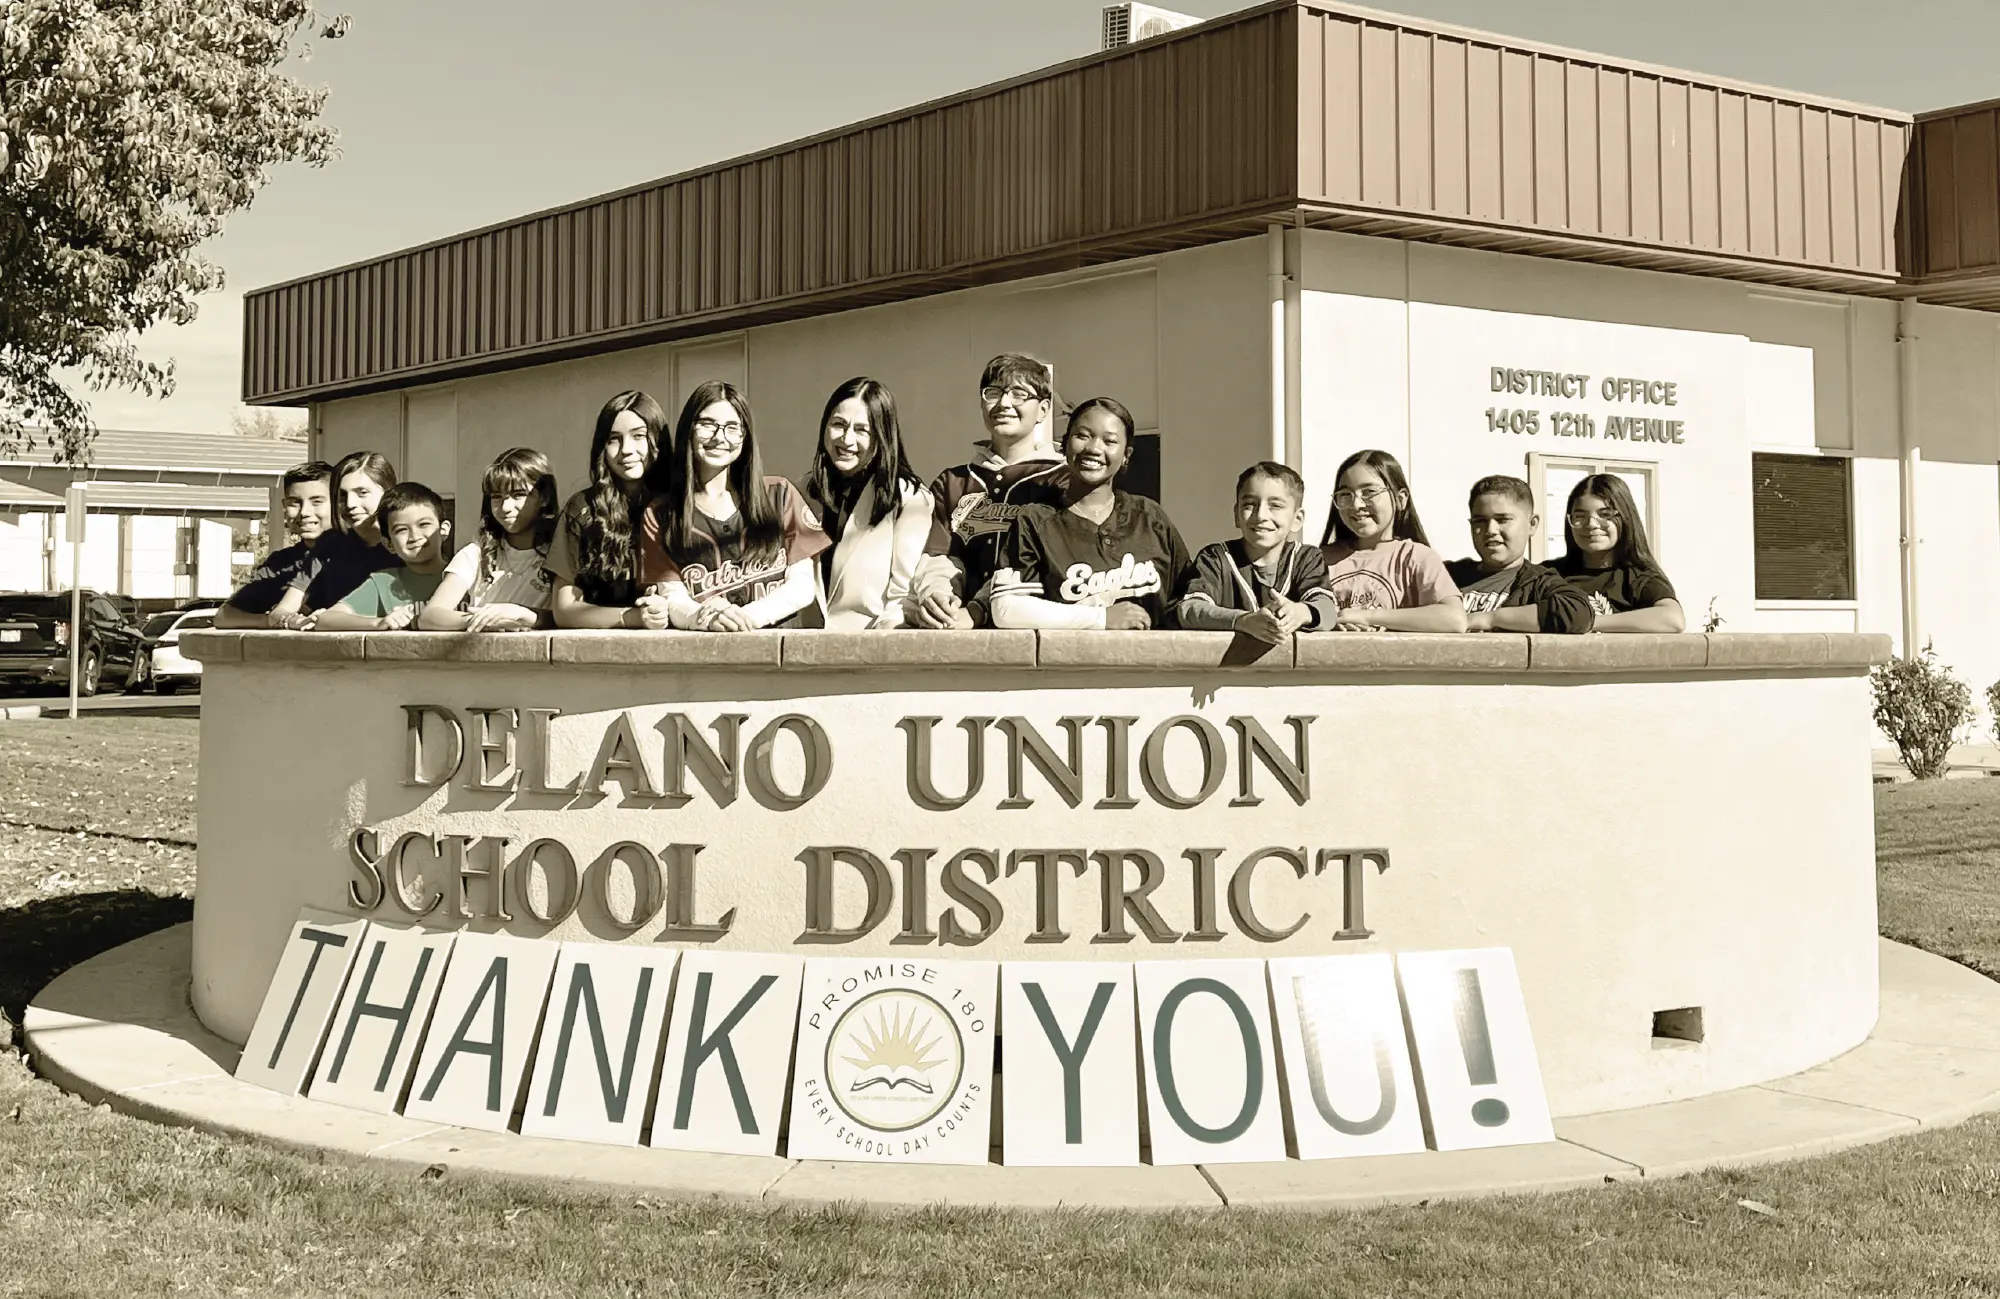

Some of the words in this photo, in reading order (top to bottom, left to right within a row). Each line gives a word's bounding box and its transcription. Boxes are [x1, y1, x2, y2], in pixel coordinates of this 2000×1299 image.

[1490, 366, 1590, 399] DISTRICT
[1601, 376, 1678, 406] OFFICE
[1485, 406, 1540, 435] 1405
[1550, 411, 1595, 438] 12th
[1603, 415, 1685, 444] AVENUE
[1060, 553, 1161, 601] Eagles
[400, 704, 834, 812] DELANO
[896, 715, 1319, 812] UNION
[347, 827, 738, 943] SCHOOL
[793, 845, 1390, 946] DISTRICT
[267, 927, 780, 1135] THANK
[808, 964, 937, 1030] PROMISE
[951, 988, 985, 1034] 180
[804, 1079, 835, 1125] EVERY
[836, 1126, 893, 1156] SCHOOL
[904, 1135, 930, 1154] DAY
[937, 1083, 981, 1138] COUNTS
